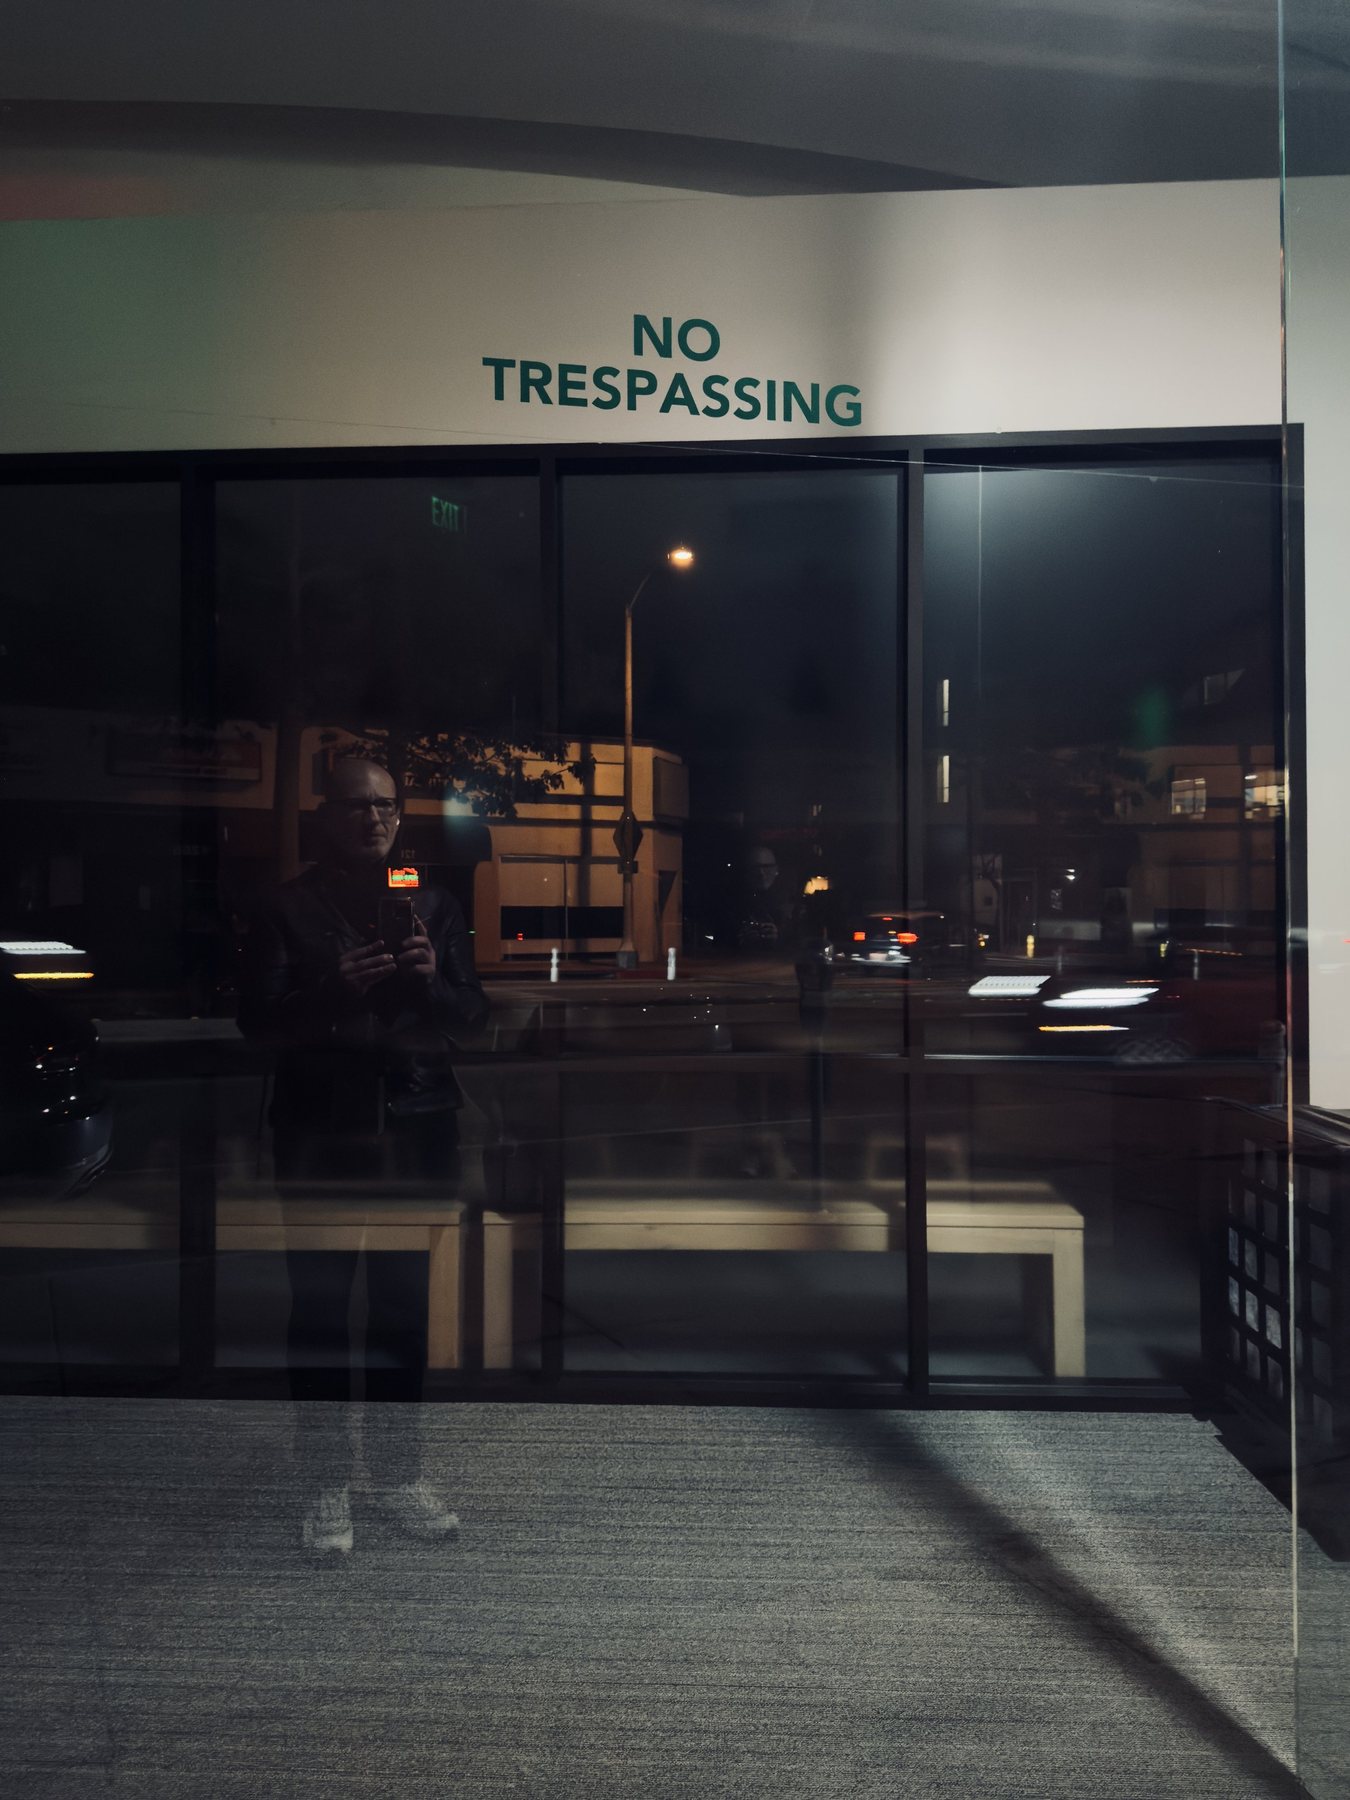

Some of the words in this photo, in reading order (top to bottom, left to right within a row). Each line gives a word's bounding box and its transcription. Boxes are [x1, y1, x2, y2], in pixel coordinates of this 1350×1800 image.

[633, 314, 721, 362] NO
[482, 356, 863, 427] TRESPASSING
[431, 495, 459, 533] EXIT
